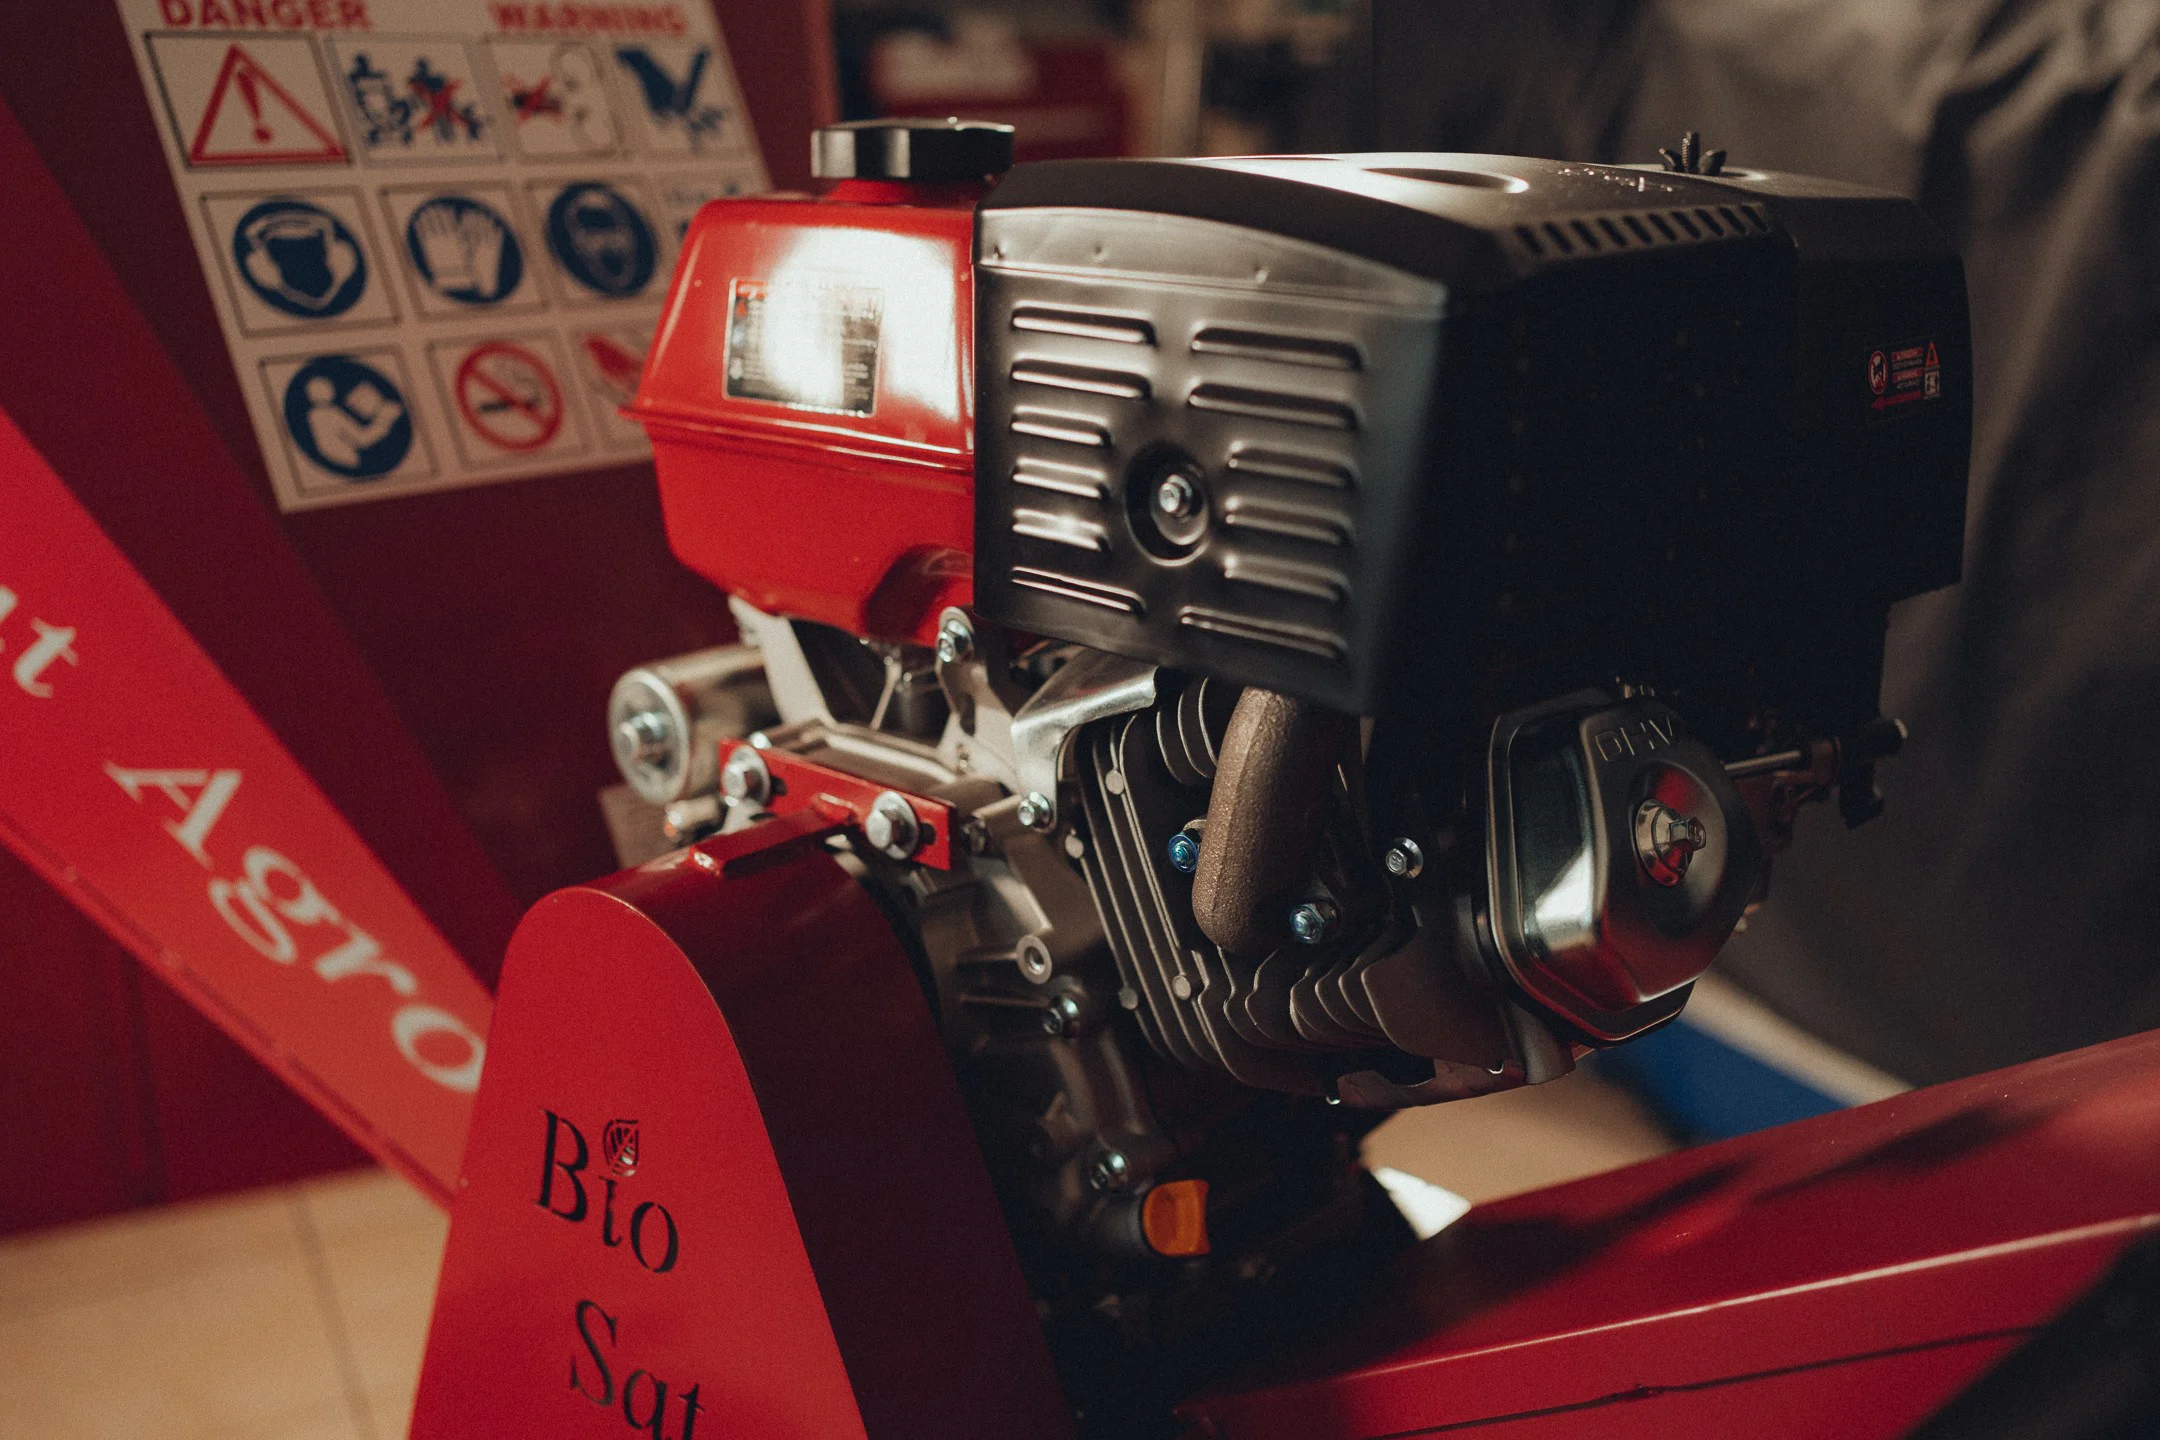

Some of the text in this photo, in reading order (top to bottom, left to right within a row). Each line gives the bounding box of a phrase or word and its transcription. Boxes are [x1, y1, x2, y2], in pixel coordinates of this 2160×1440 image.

[162, 0, 371, 36] DANGER
[494, 0, 687, 36] WARNING
[105, 762, 487, 1093] Agro
[536, 1109, 679, 1273] Bio
